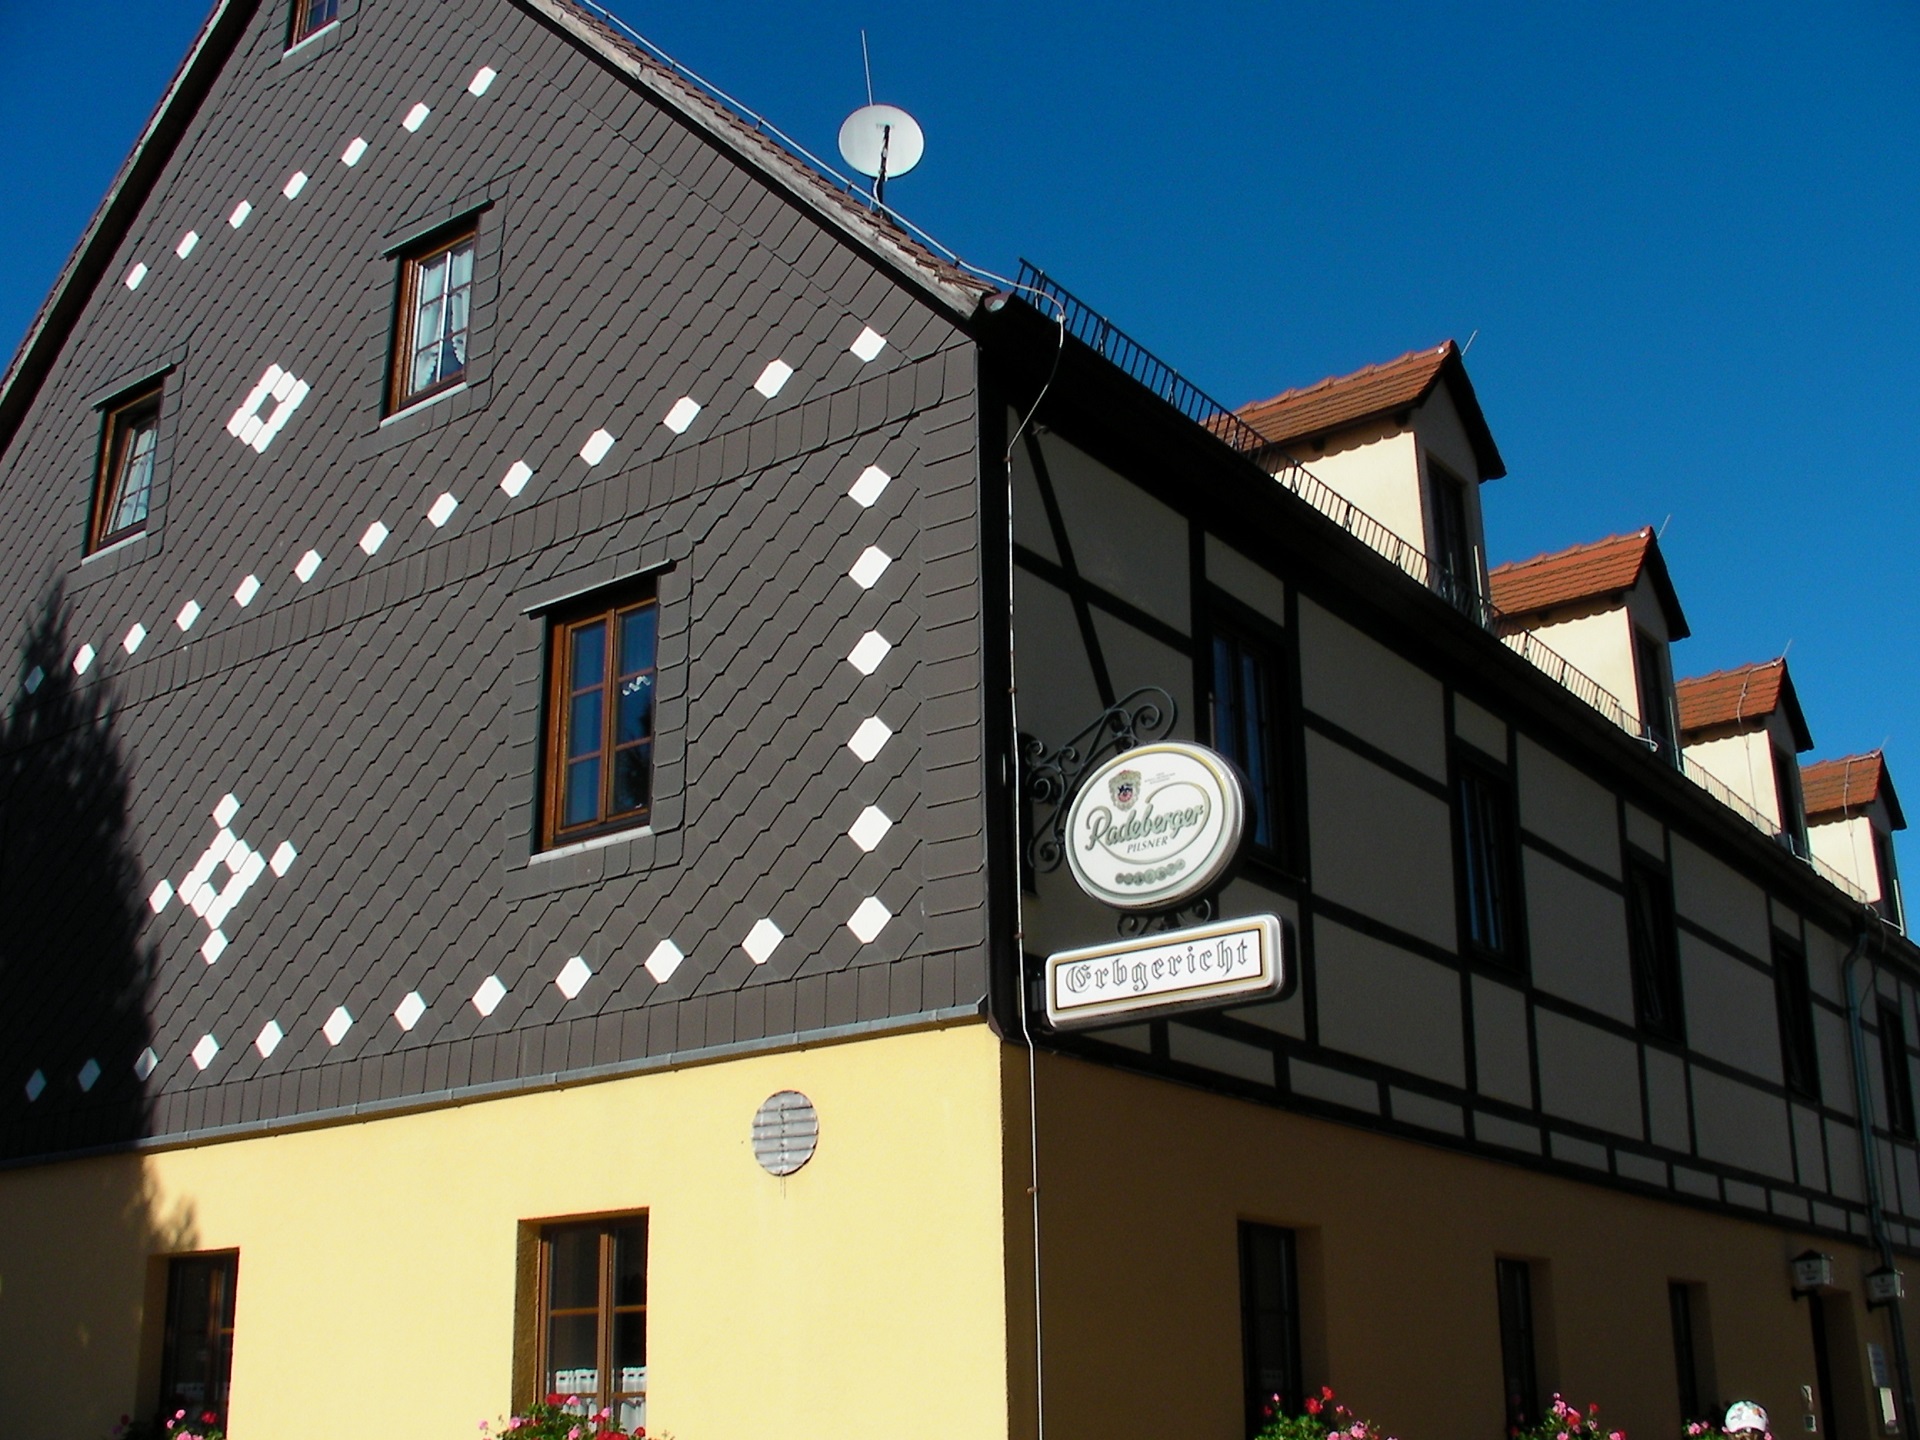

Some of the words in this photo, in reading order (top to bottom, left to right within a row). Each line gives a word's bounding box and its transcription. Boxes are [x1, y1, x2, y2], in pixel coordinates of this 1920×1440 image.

[1085, 804, 1204, 851] Radeberger
[1126, 836, 1169, 854] PILSNER
[1065, 938, 1248, 994] Erbgericht
